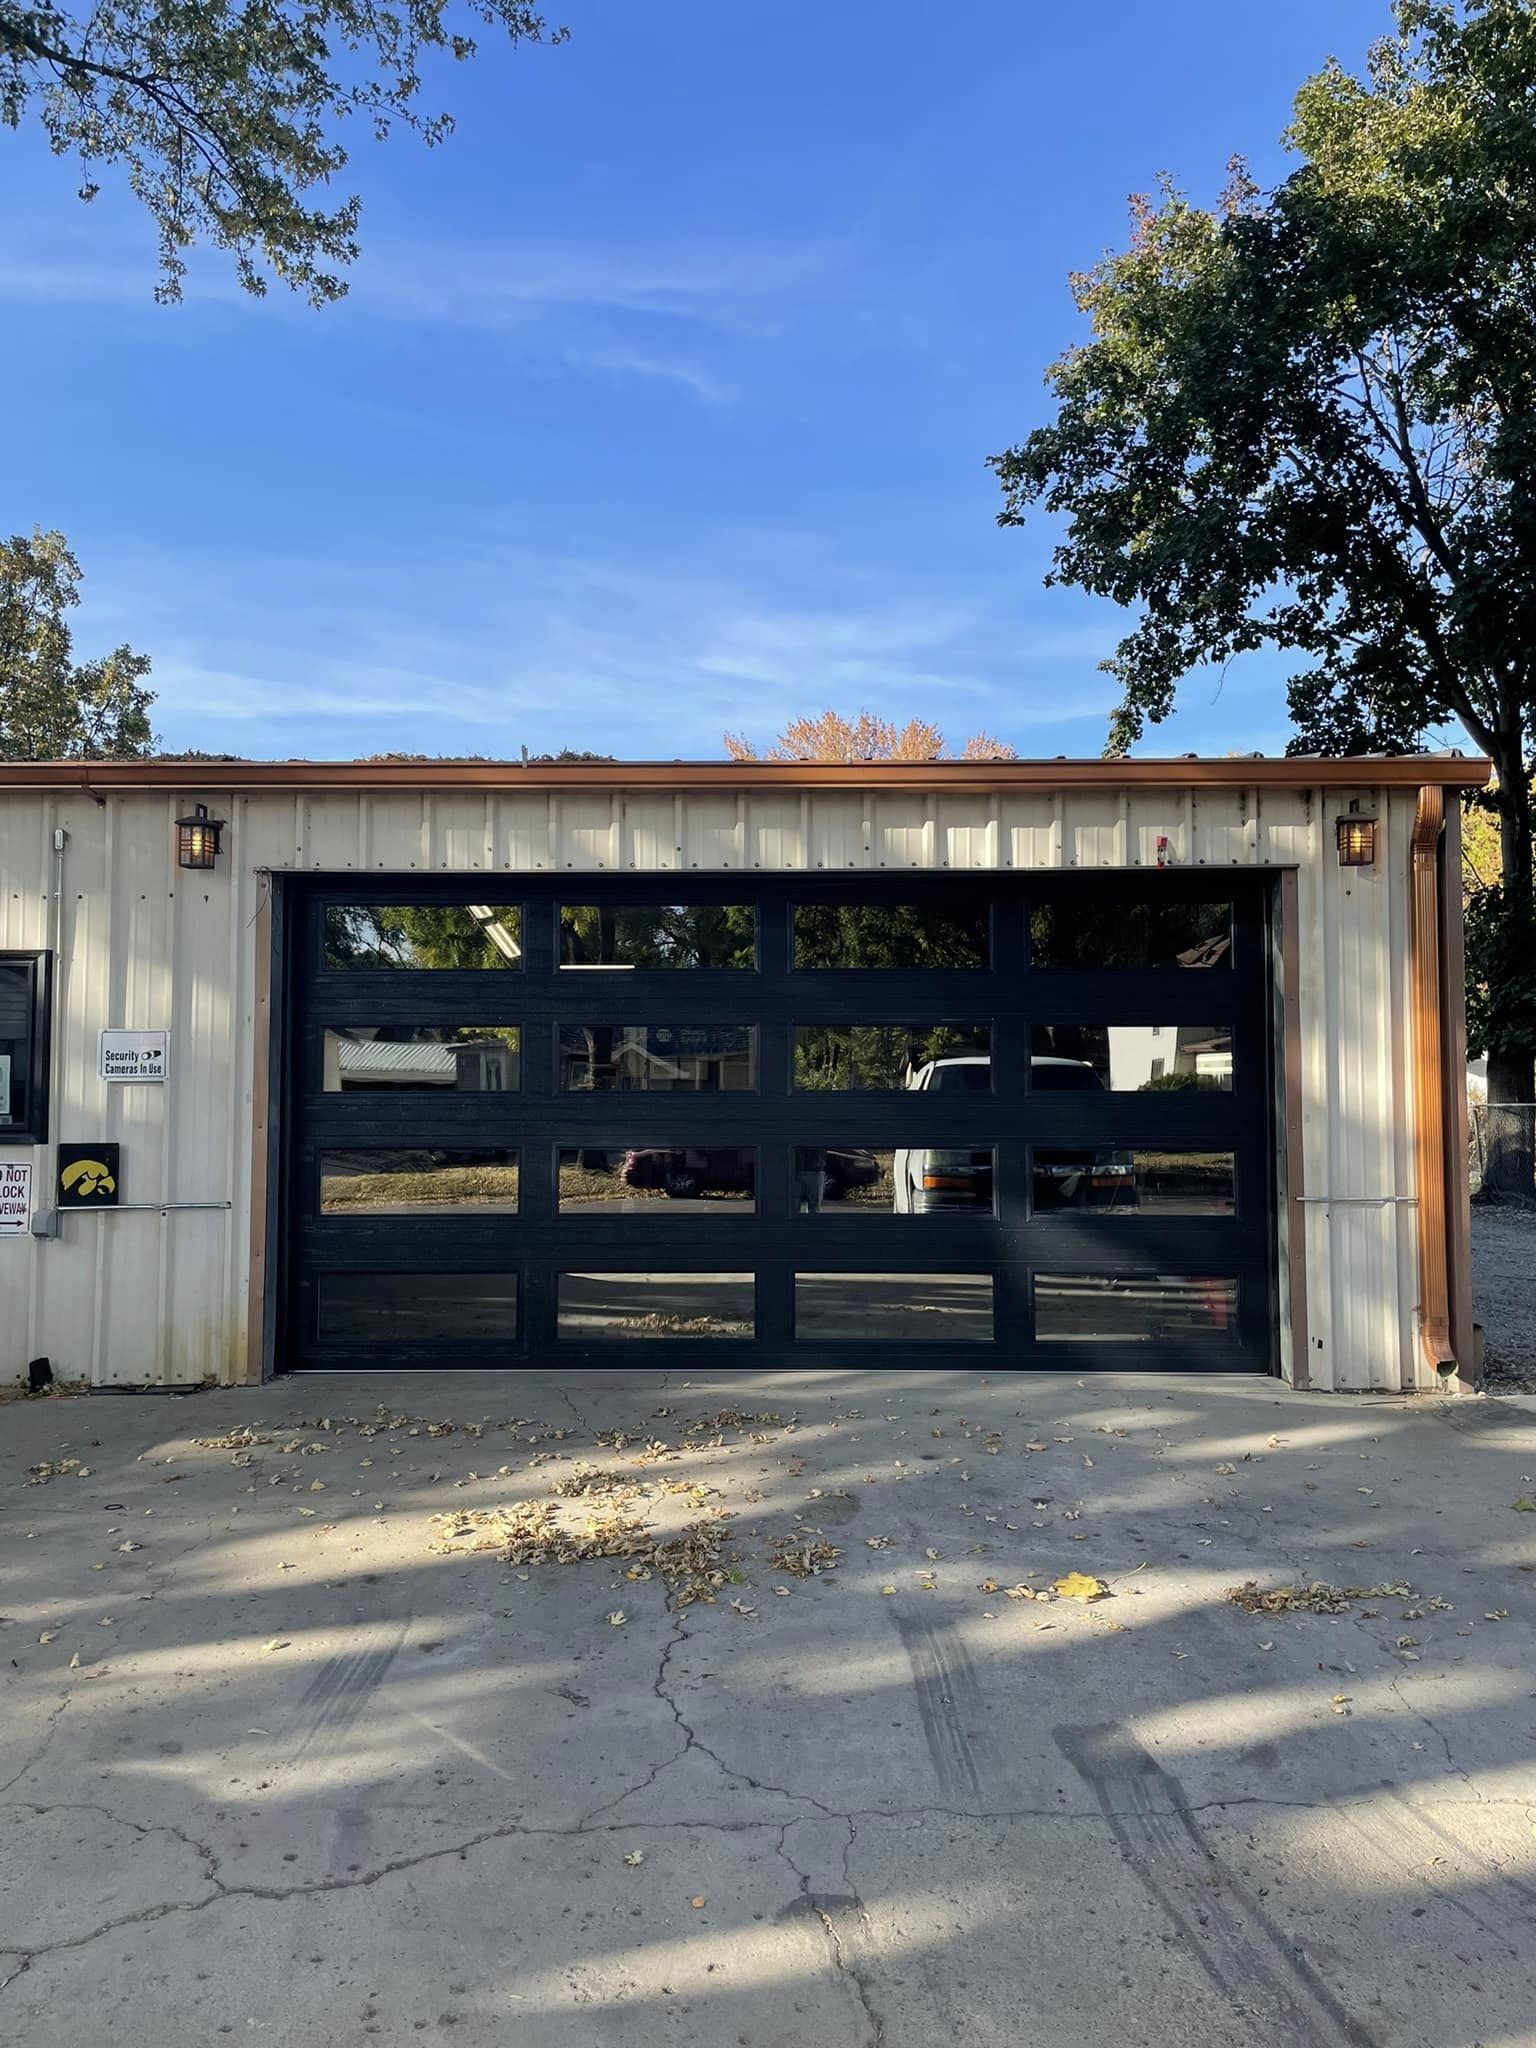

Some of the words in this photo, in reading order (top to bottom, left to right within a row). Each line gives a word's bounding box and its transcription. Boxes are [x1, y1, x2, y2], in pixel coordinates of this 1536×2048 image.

[105, 1050, 139, 1063] Security
[105, 1063, 138, 1074] Cameras
[140, 1063, 147, 1074] In
[149, 1063, 162, 1074] Use
[6, 1169, 28, 1182] NOT
[0, 1185, 25, 1198] OCK
